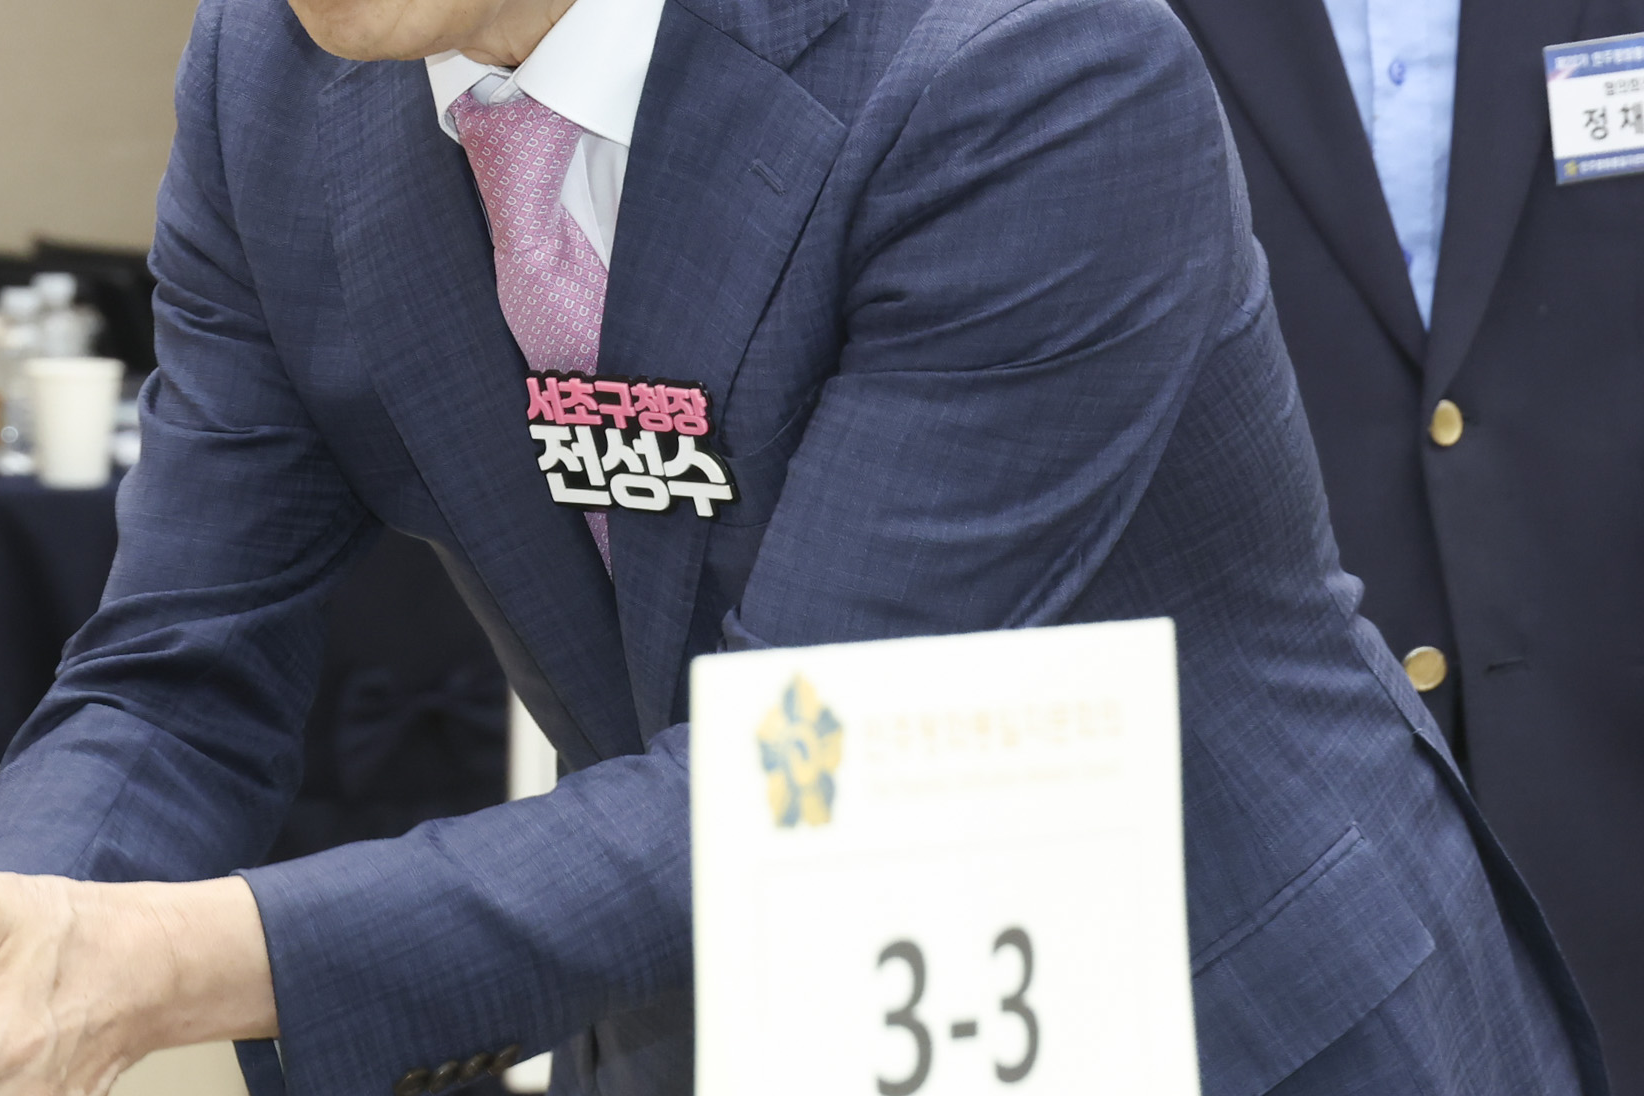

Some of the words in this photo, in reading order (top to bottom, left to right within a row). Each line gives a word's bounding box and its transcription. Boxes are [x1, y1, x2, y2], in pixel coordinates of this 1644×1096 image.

[526, 377, 709, 436] 서초구청장
[529, 424, 733, 517] 전성수
[876, 925, 1040, 1096] 3-3
